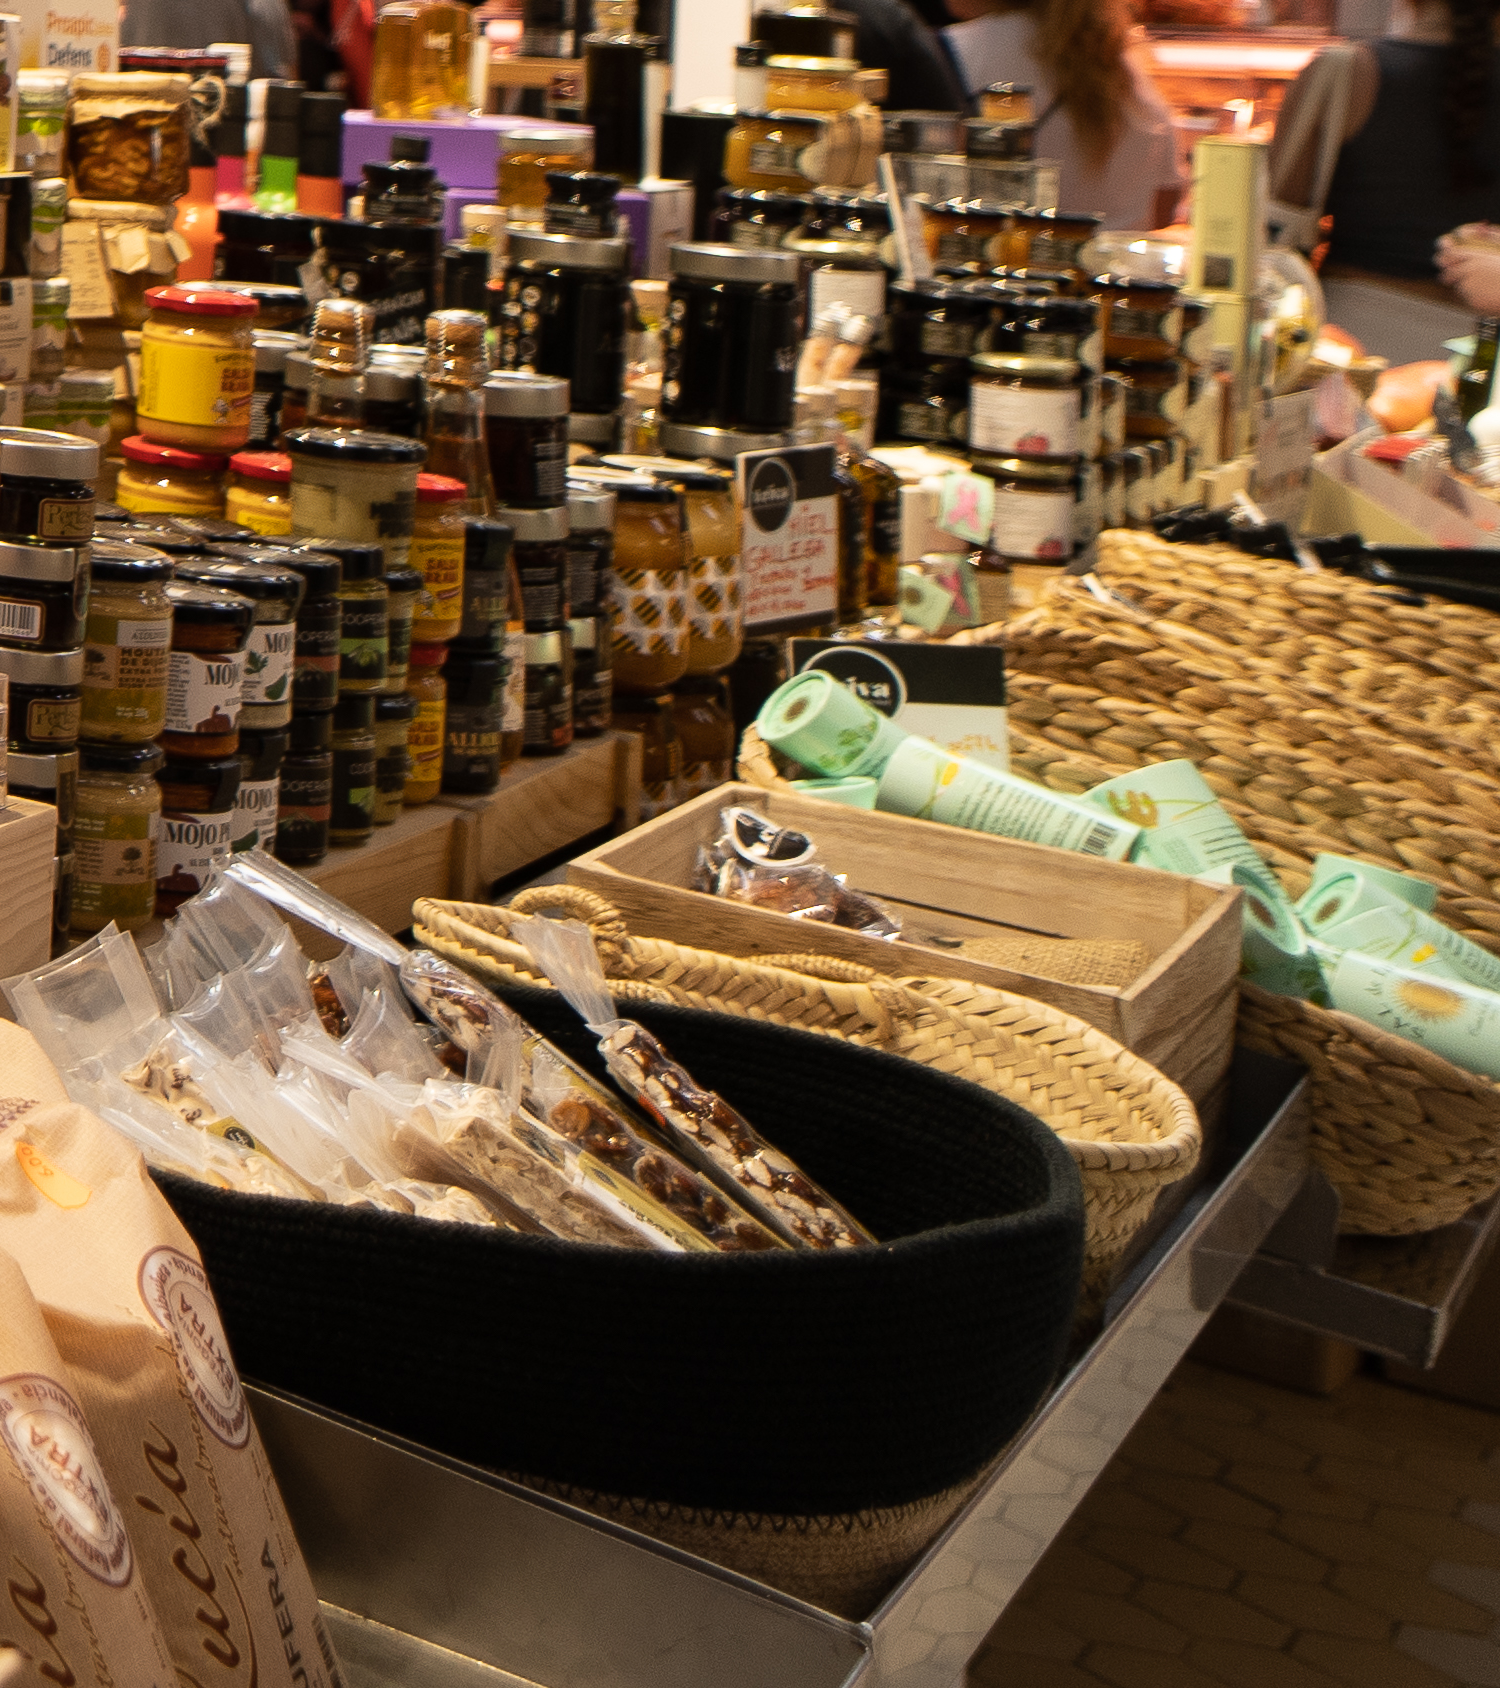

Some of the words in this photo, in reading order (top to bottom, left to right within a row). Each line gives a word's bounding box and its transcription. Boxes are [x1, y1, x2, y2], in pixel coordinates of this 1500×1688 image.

[49, 42, 92, 67] Defens
[164, 821, 218, 846] MOJO
[179, 1292, 235, 1393] EXTRA
